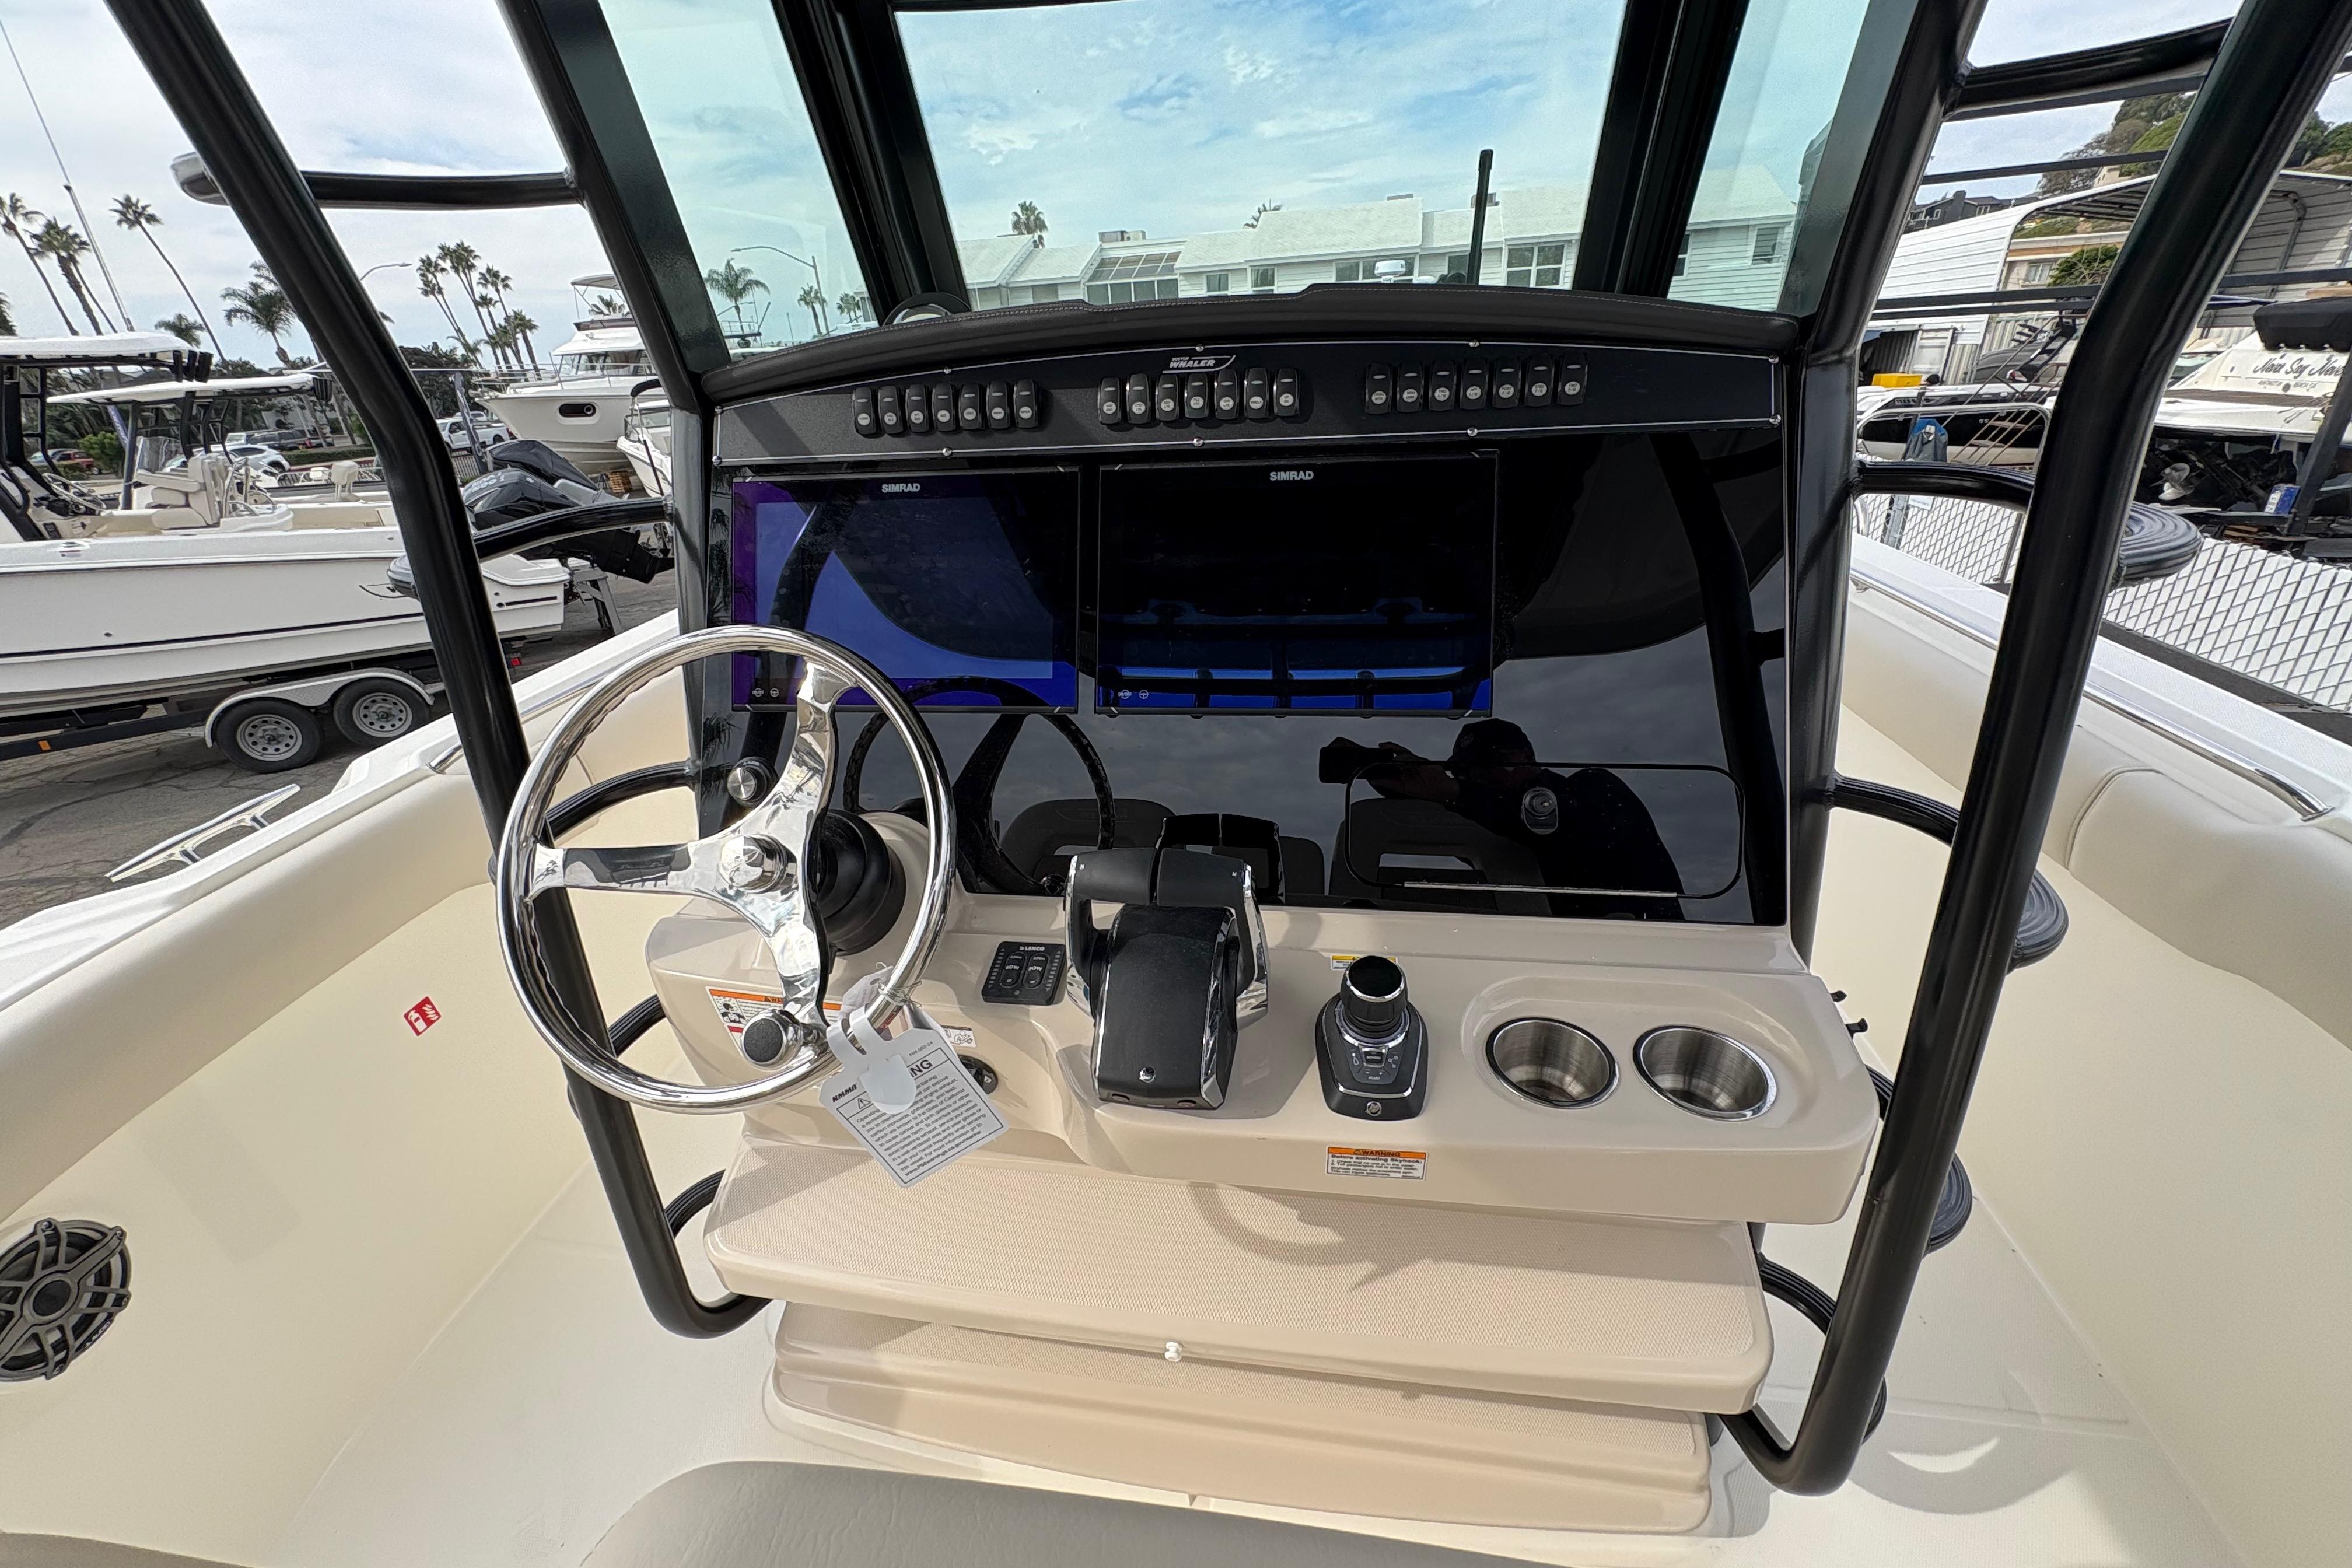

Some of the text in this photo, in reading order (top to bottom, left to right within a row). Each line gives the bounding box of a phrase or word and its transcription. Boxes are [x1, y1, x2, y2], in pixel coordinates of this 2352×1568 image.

[1169, 359, 1216, 369] WHALER
[2285, 356, 2311, 379] Say
[1269, 470, 1314, 481] SIMRAD
[881, 483, 921, 493] SIMRAD
